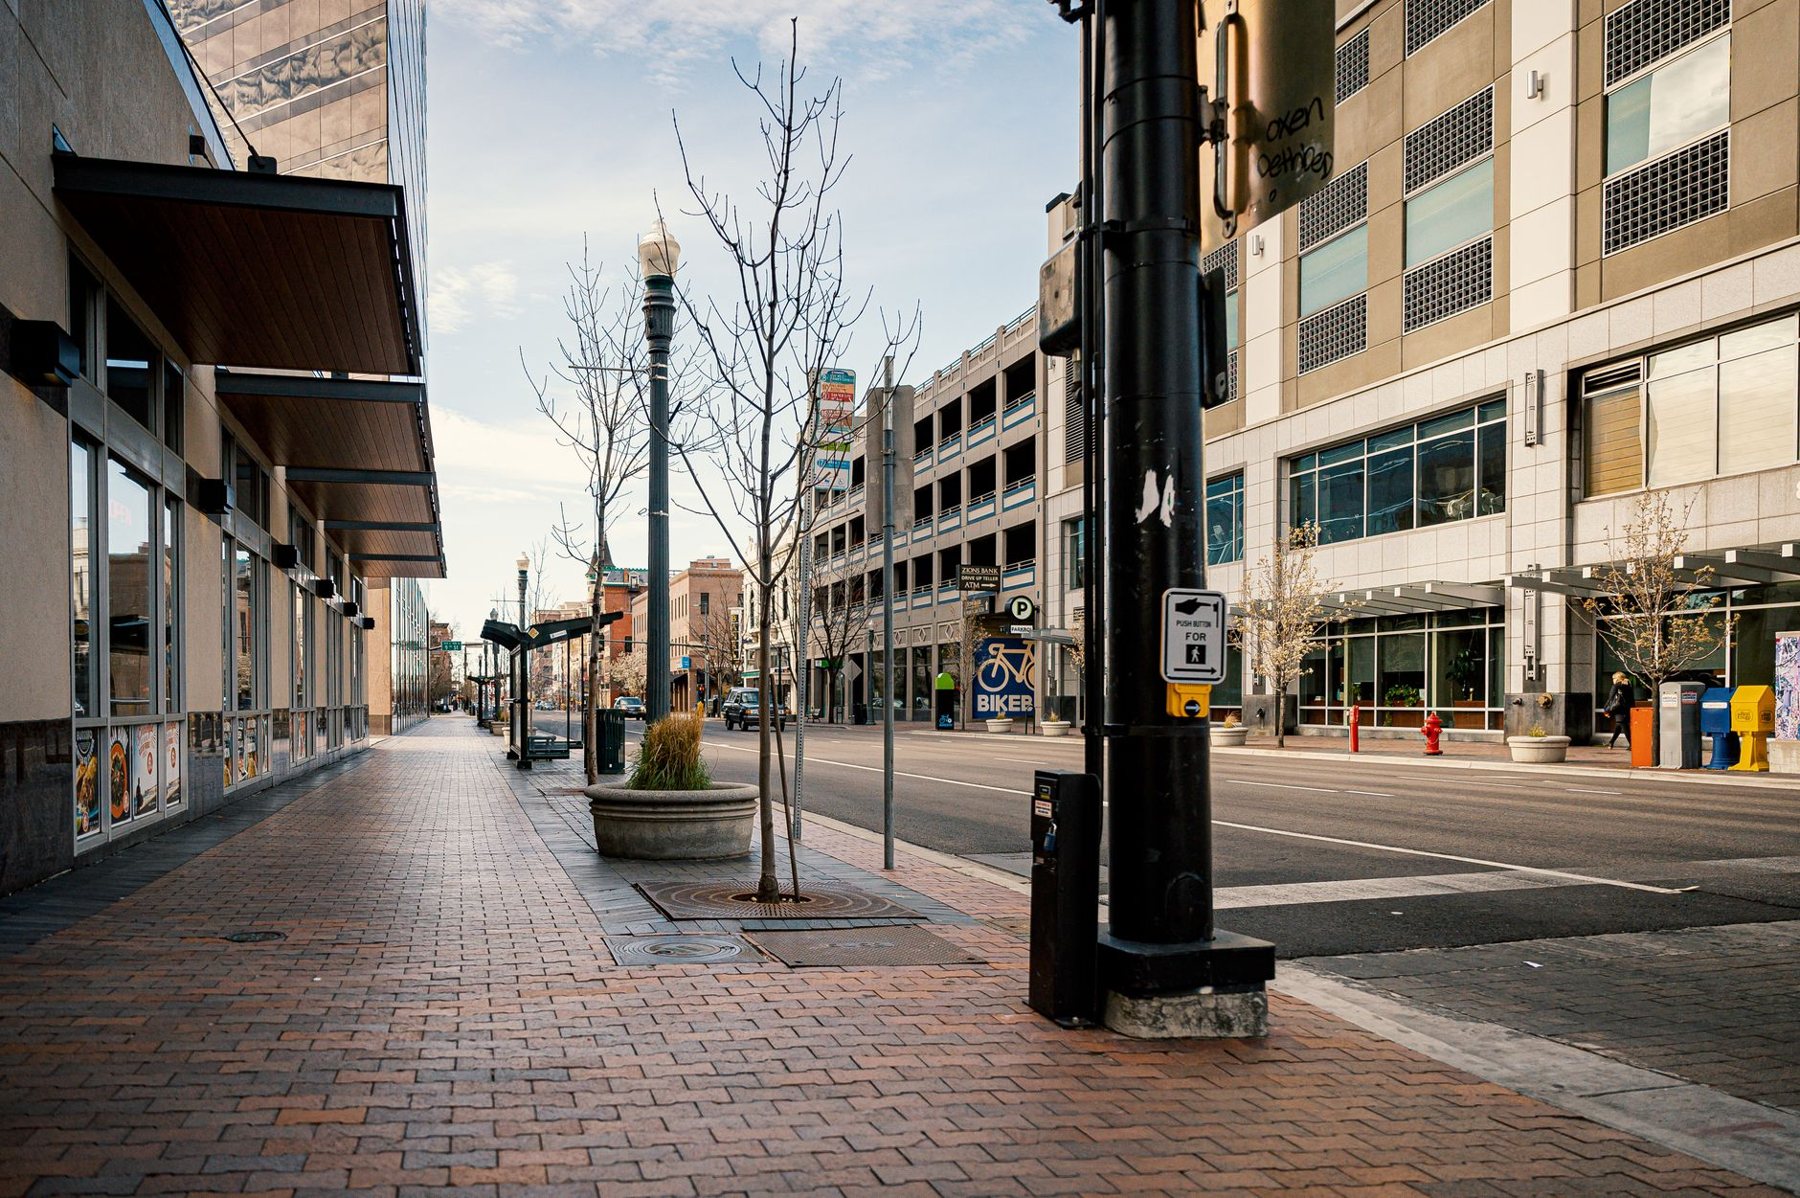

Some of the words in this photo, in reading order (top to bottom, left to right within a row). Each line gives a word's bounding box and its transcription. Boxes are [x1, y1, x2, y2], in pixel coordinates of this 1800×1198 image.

[961, 567, 980, 575] ZIONS
[964, 581, 980, 589] ATM
[1017, 601, 1028, 616] P
[1186, 632, 1206, 641] FOR
[977, 694, 1033, 711] BIKER
